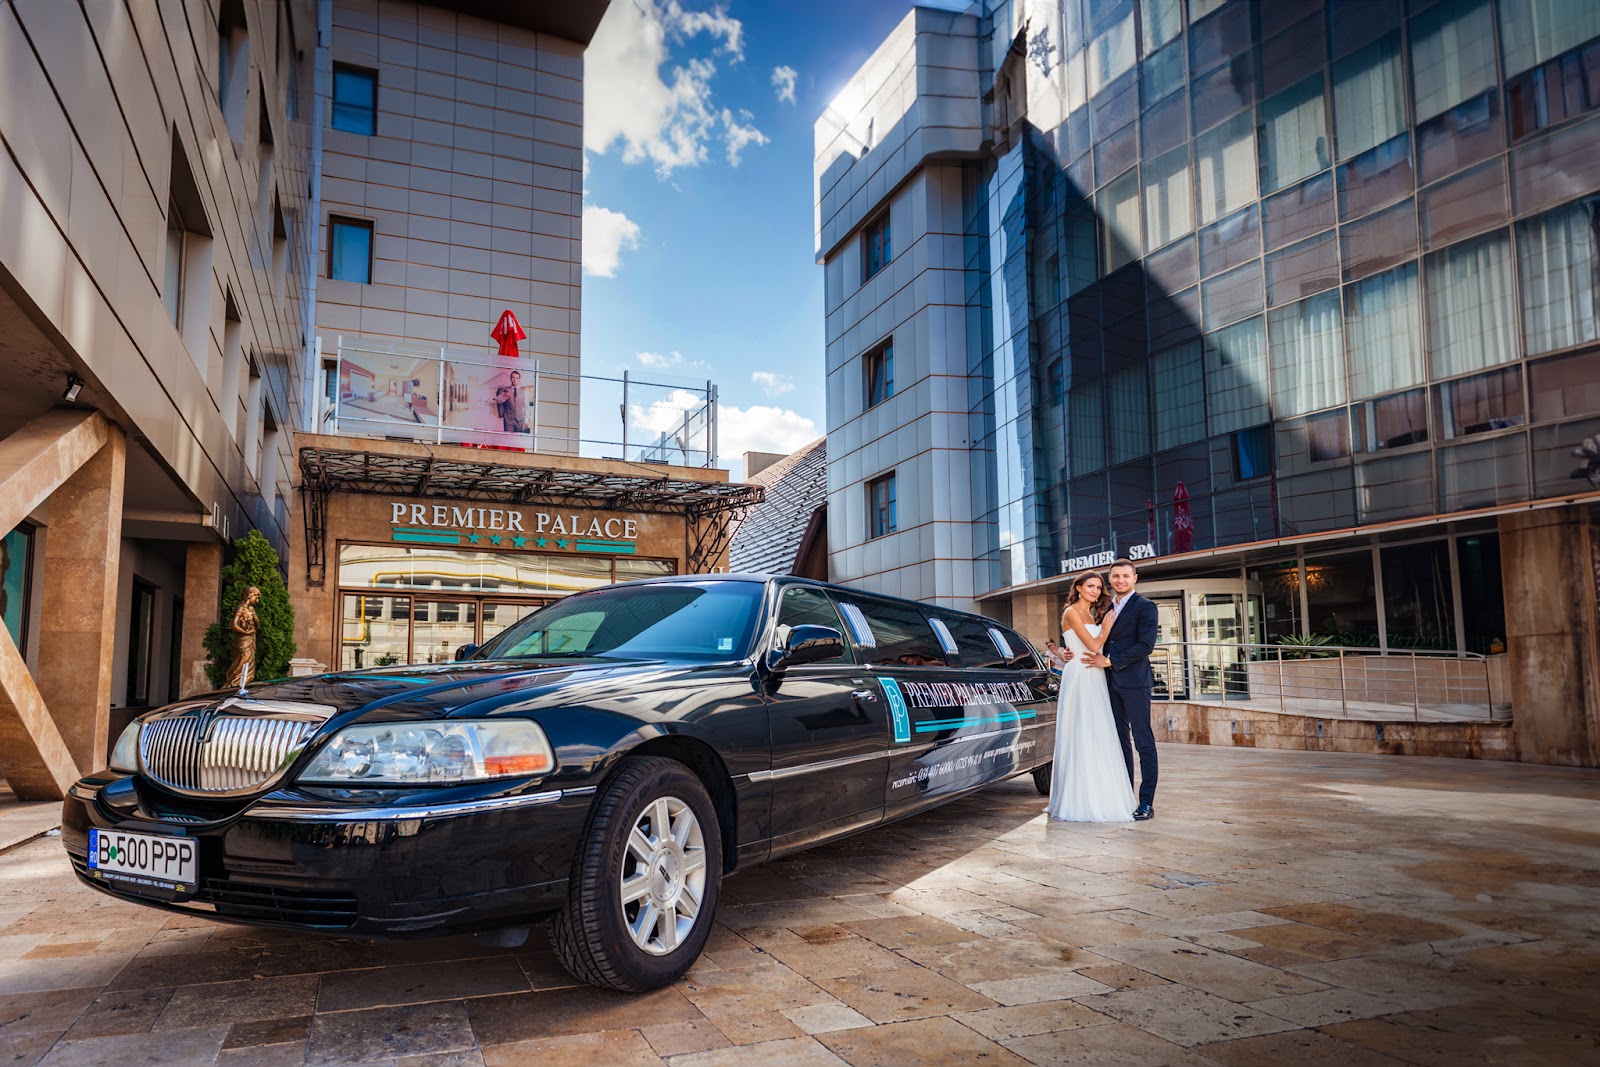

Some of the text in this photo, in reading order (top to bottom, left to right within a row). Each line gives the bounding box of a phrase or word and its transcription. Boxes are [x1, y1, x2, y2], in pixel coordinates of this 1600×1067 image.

[390, 502, 638, 539] PREMIER PALACE
[1061, 543, 1155, 573] PREMIER SPA
[902, 682, 958, 708] PREMIER
[952, 682, 991, 706] PALACE
[987, 682, 1017, 704] HOTEL
[1017, 682, 1034, 701] SPA
[90, 850, 97, 864] RO
[99, 834, 192, 876] B 500 PPP
